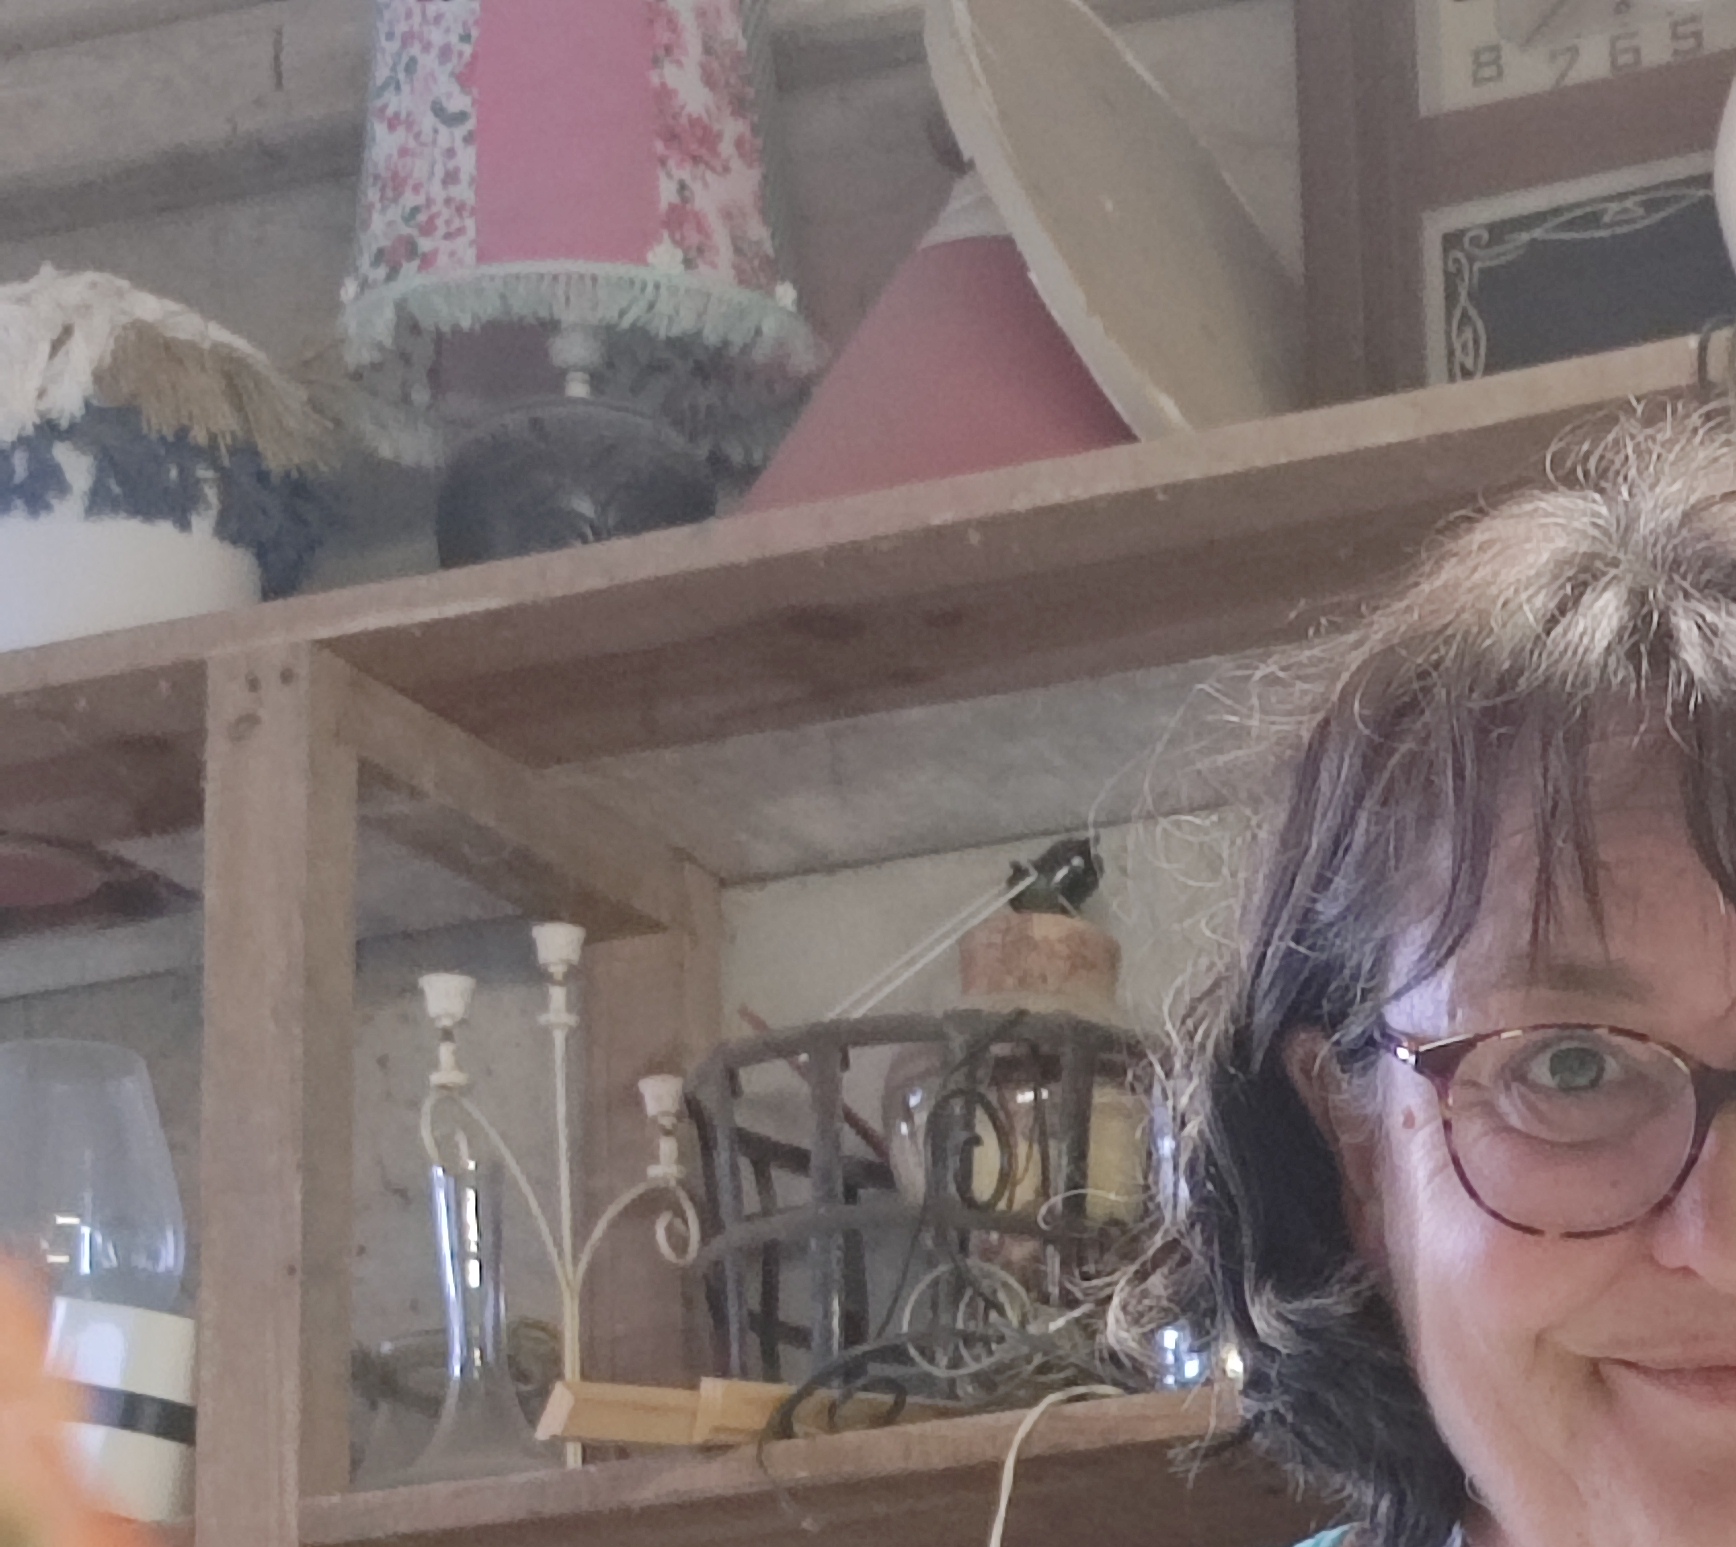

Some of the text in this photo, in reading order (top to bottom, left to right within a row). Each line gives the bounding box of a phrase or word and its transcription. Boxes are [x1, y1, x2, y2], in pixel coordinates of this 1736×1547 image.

[1471, 14, 1704, 88] 8 7 6 5
